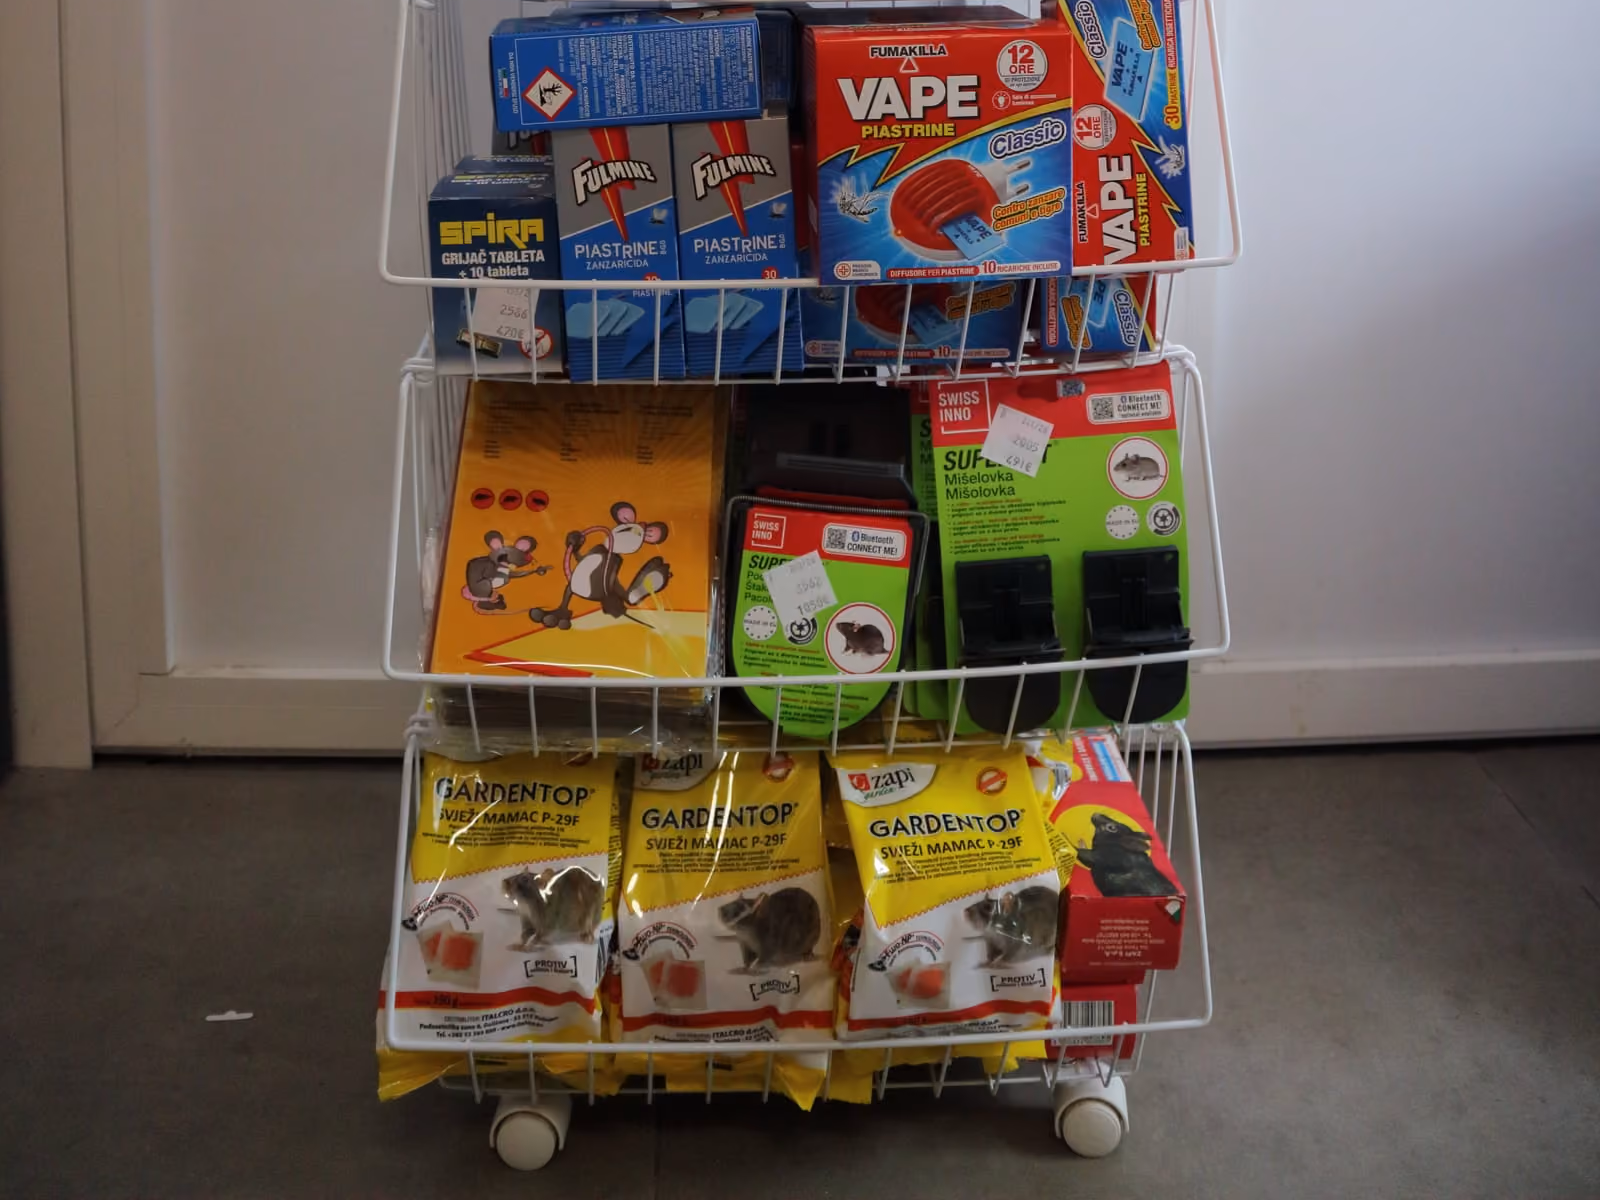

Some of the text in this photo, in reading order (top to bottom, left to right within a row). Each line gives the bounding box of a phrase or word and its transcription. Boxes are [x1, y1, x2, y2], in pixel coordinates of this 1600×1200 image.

[1078, 2, 1105, 57] Classic
[869, 45, 948, 58] FUMAKILLA
[1008, 44, 1035, 64] 12
[1009, 64, 1035, 74] ORE
[1111, 40, 1128, 87] VAPE
[837, 75, 981, 121] VAPE
[1164, 106, 1180, 125] 30
[861, 122, 955, 139] PIASTRINE
[1076, 116, 1093, 141] 12
[1093, 116, 1101, 139] ORE
[992, 120, 1064, 157] Classic
[573, 158, 657, 206] FULMINE
[692, 153, 776, 200] FULMINE
[1076, 182, 1088, 243] FUMAKILLA
[1098, 154, 1137, 265] VAPE
[1136, 173, 1151, 246] PIASTRINE
[439, 212, 545, 249] SPIRA
[967, 214, 993, 240] VAPE
[575, 240, 658, 259] PIASTRINE
[694, 234, 777, 253] PIASTRINE
[441, 248, 545, 265] GRIJAČ TABLETA
[586, 259, 649, 270] ZANZARICIDA
[705, 253, 769, 265] ZANZARICIDA
[471, 267, 483, 277] 10
[487, 265, 529, 277] tableta
[764, 269, 777, 279] 30
[890, 269, 926, 277] DIFFUSORE
[941, 267, 974, 276] PIASTRINE
[982, 260, 996, 274] 10
[997, 264, 1031, 272] RICARICHE
[633, 288, 673, 297] PIASTINE
[1115, 290, 1139, 346] Classic
[939, 391, 980, 407] SWISS
[1128, 392, 1161, 402] Bluetooth
[940, 407, 971, 422] INNO
[1117, 403, 1149, 412] CONNECT
[944, 470, 1014, 486] Mišelovka
[945, 485, 1016, 501] Mišolovka
[753, 520, 779, 531] SWISS
[752, 530, 773, 540] INNO
[860, 533, 894, 544] Bluetooth
[847, 543, 898, 556] CONNECT ME!
[871, 768, 916, 790] zapi
[436, 777, 589, 807] GARDENTOP
[483, 810, 539, 825] MAMAC
[541, 812, 580, 826] P-29F
[642, 803, 793, 830] GARDENTOP
[869, 808, 1021, 838] GARDENTOP
[646, 833, 787, 851] SVJEŽI MAMAC P-29F
[881, 842, 923, 860] SVJEŽI
[927, 838, 985, 855] MAMAC
[534, 959, 568, 969] PROTIV
[1001, 973, 1036, 984] PROTIV
[481, 1008, 514, 1021] ITALCRO
